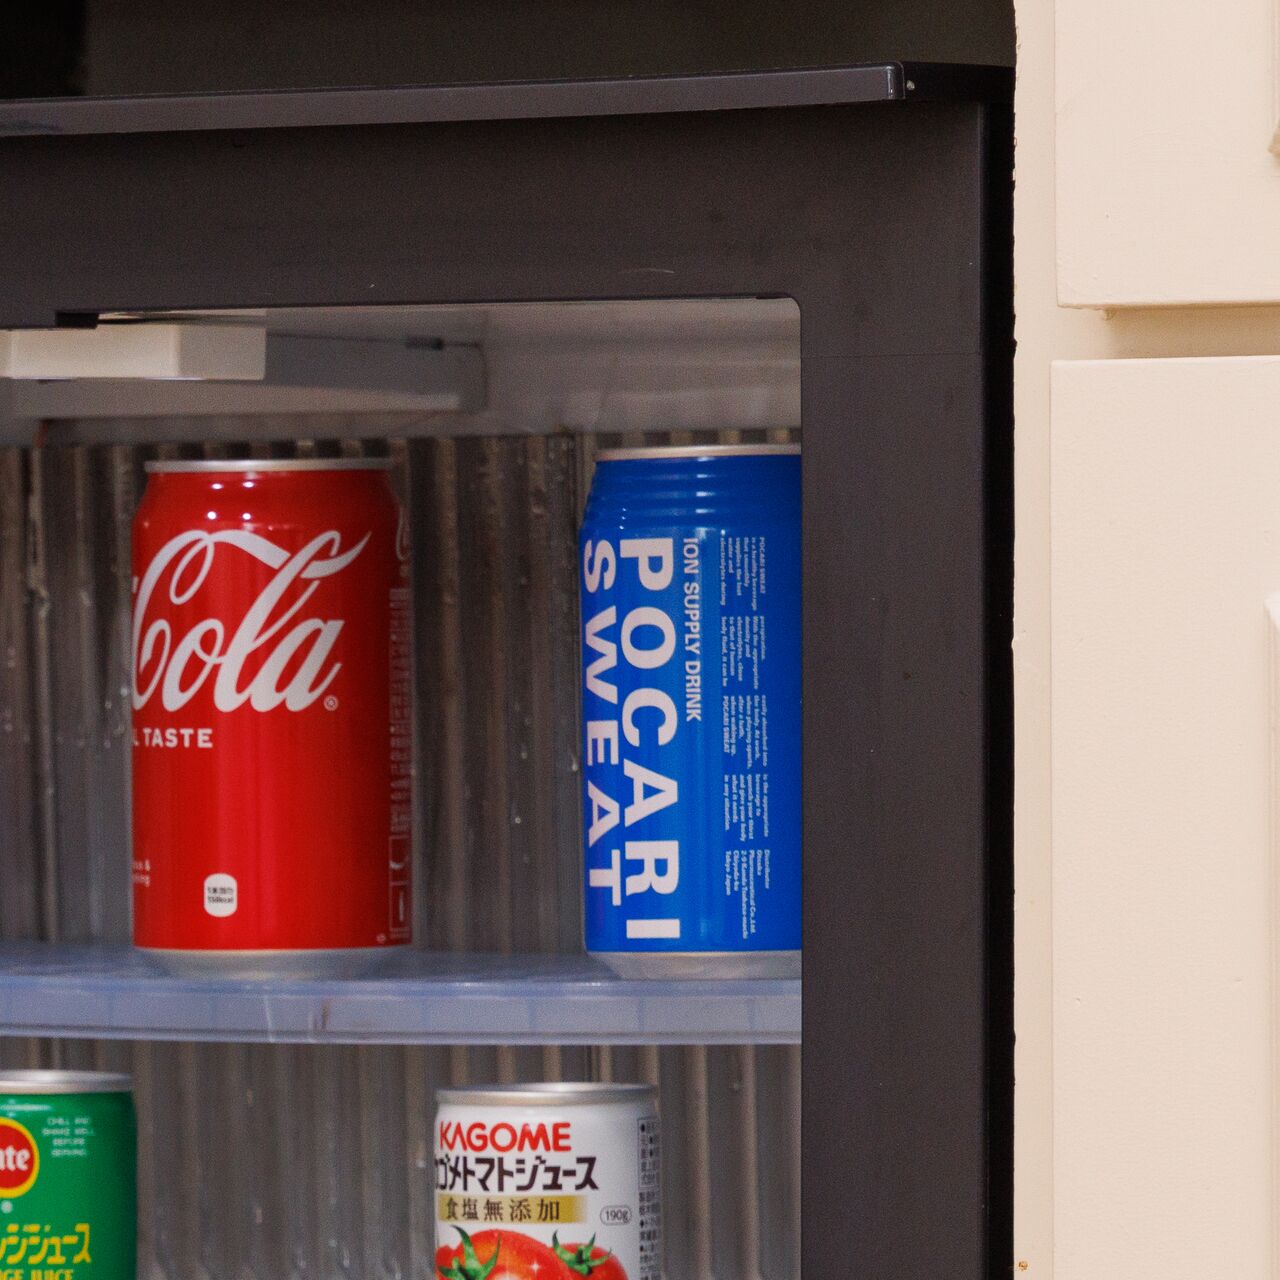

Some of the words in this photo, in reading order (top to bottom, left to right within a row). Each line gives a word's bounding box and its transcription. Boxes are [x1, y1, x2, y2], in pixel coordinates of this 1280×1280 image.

[683, 537, 698, 577] ION
[132, 529, 371, 712] Cola
[685, 583, 701, 656] SUPPLY
[686, 659, 701, 722] DRINK
[144, 728, 213, 749] TASTE
[584, 539, 622, 906] SWEAT
[619, 537, 681, 940] POCARI
[440, 1121, 572, 1152] KAGOME
[446, 1197, 560, 1222] 食塩無添加
